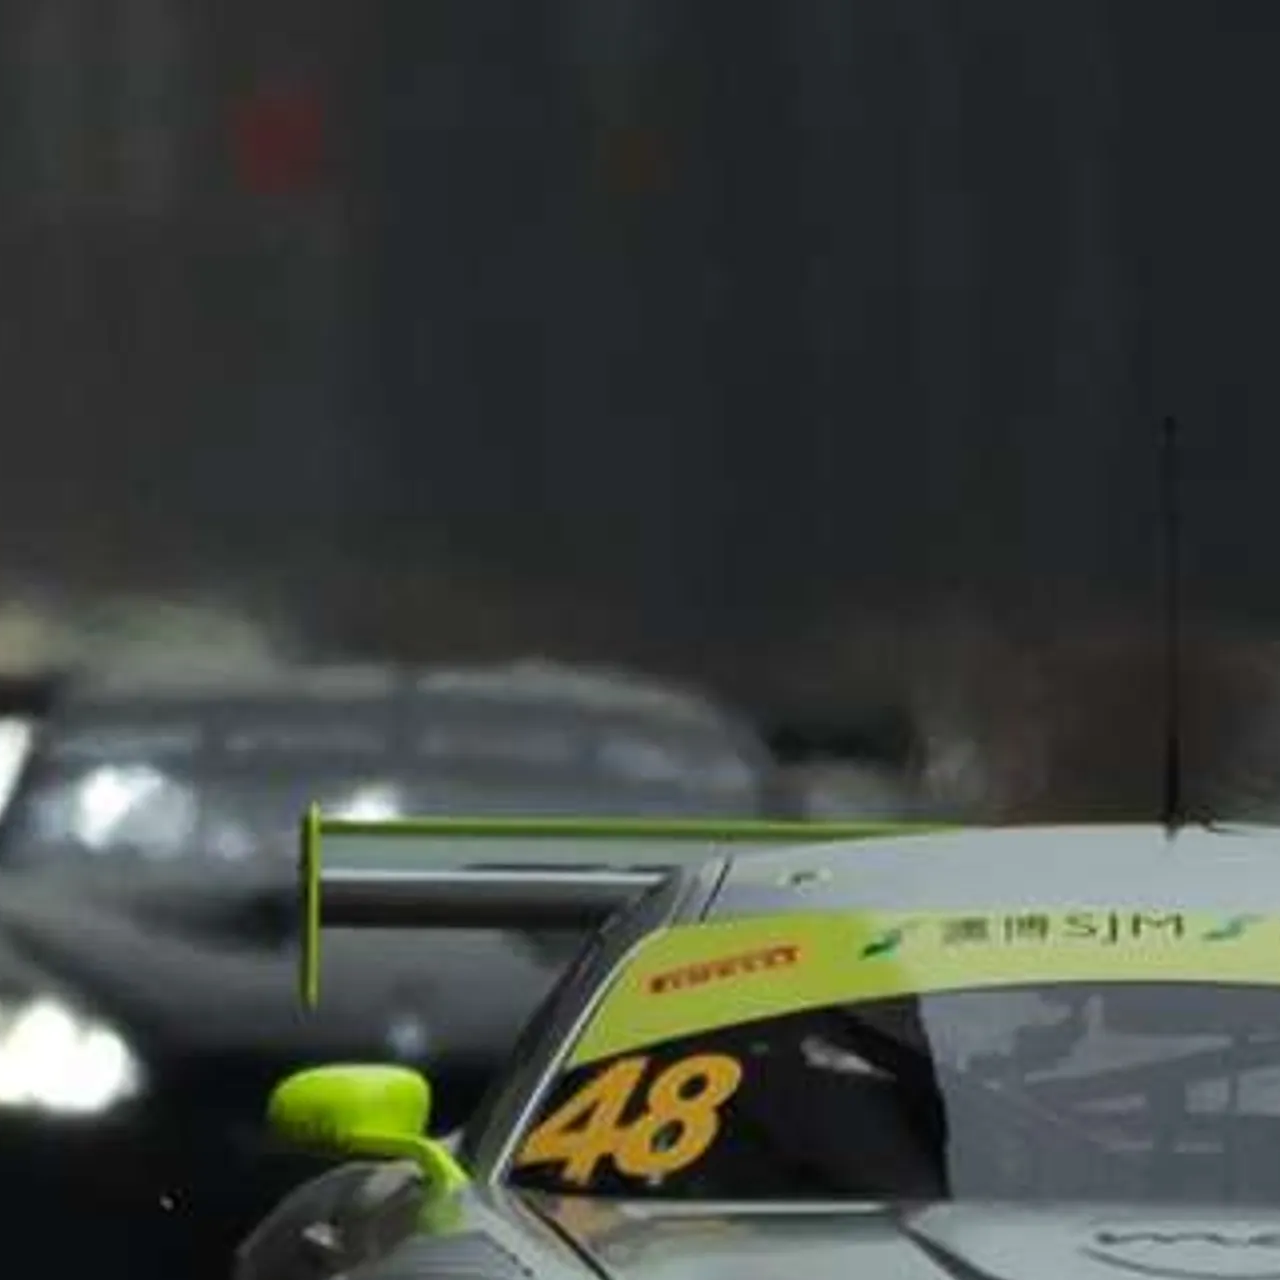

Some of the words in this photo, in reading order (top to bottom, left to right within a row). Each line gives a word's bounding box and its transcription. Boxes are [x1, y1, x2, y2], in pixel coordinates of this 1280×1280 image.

[1063, 911, 1184, 945] SJM
[649, 945, 799, 993] PIRELLI
[518, 1055, 743, 1185] 48
